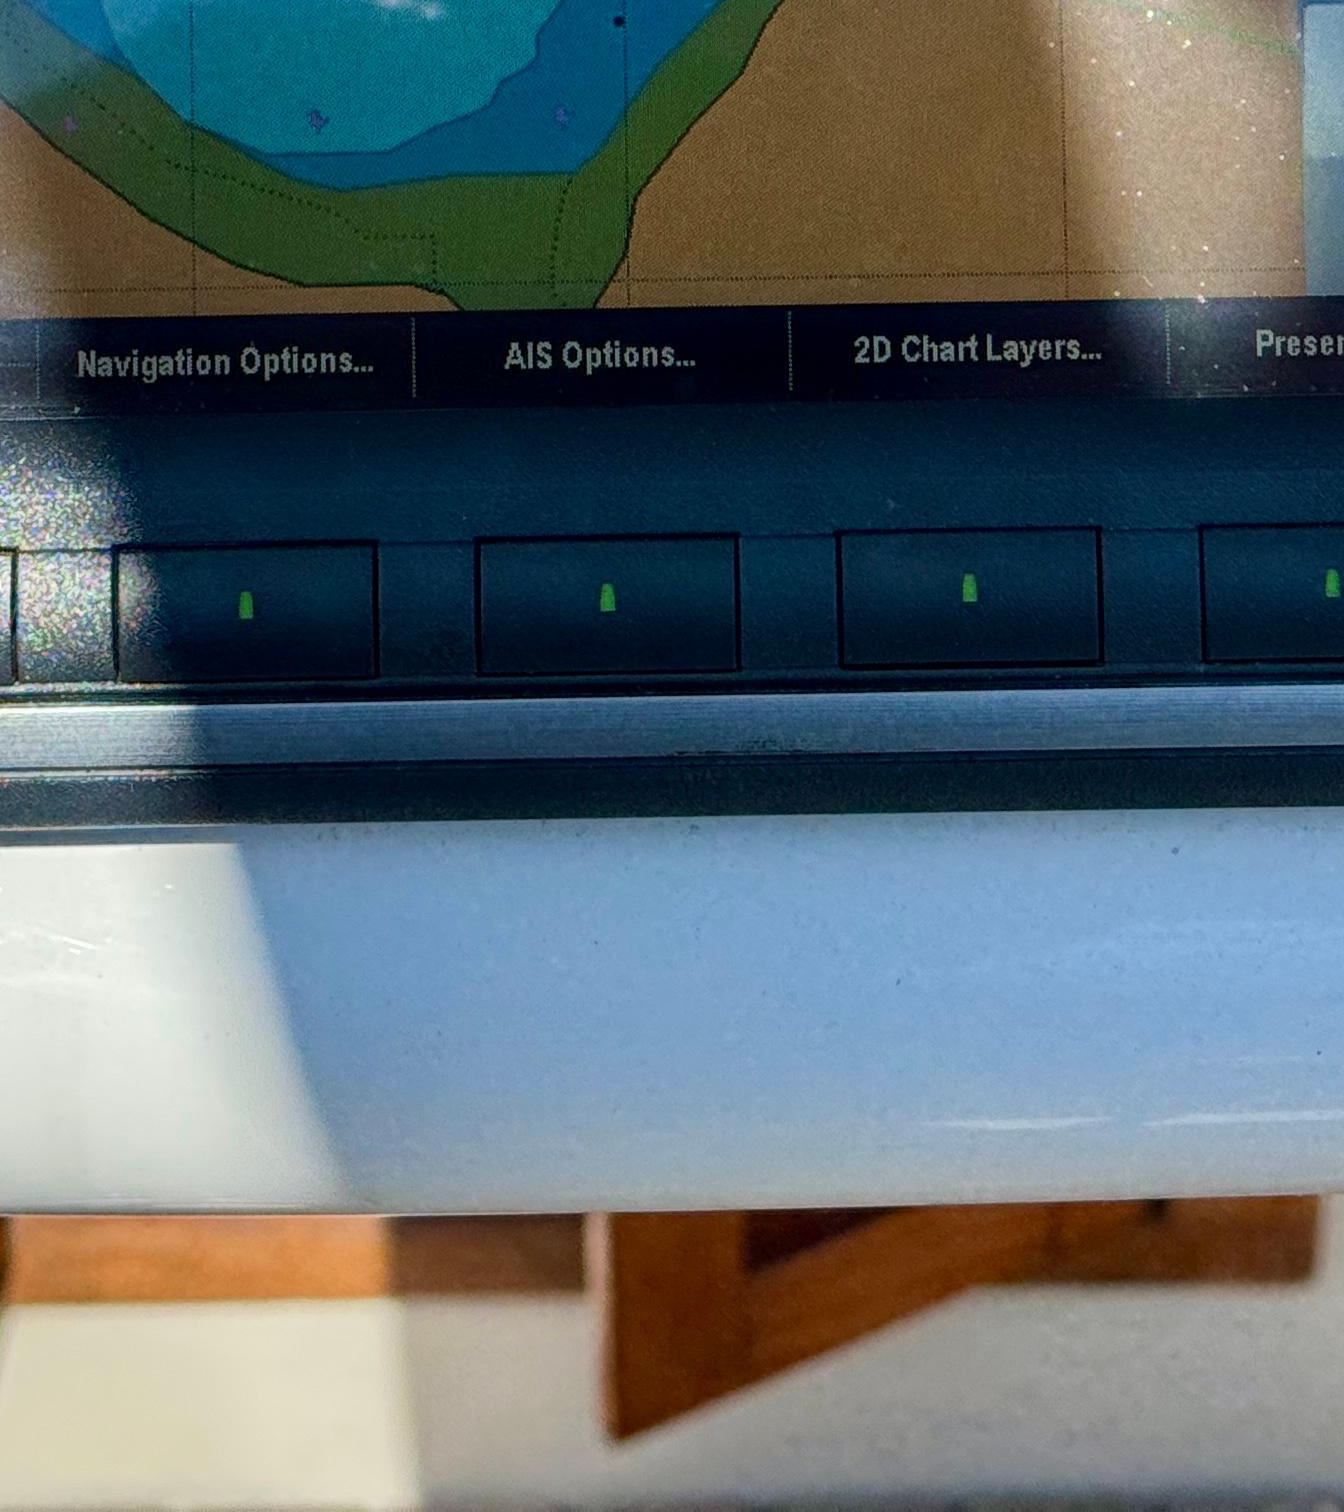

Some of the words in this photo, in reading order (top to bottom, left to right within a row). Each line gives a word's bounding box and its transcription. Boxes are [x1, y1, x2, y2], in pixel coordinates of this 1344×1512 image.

[77, 350, 230, 382] Navigation
[240, 346, 374, 380] Options...
[504, 341, 552, 370] AIS
[562, 340, 696, 374] Options...
[854, 336, 891, 364] 2D
[901, 334, 979, 363] Chart
[986, 333, 1103, 367] Layers...
